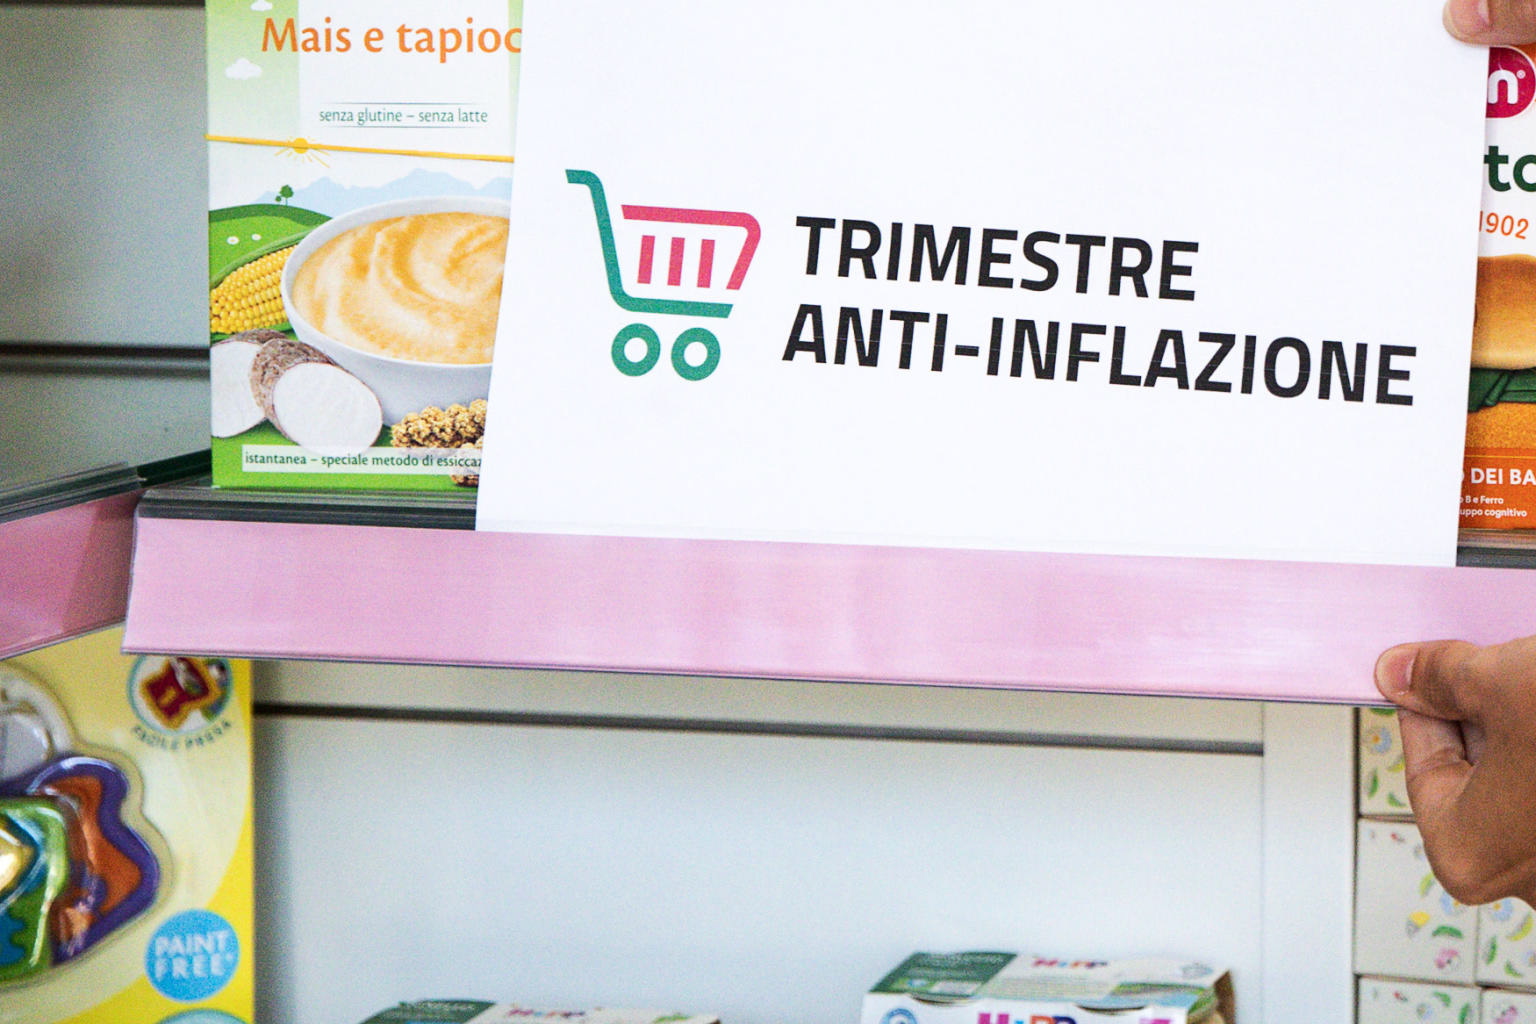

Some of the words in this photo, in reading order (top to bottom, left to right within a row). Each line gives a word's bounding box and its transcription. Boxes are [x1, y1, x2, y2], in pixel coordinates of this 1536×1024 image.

[261, 17, 352, 54] Mais
[363, 27, 384, 53] e
[396, 17, 522, 64] tapioc
[320, 111, 354, 123] senza
[357, 109, 402, 126] glutine
[418, 111, 456, 123] senza
[458, 109, 488, 123] latte
[796, 216, 1200, 301] TRIMESTRE
[782, 303, 1417, 407] ANTI-INFLAZIONE
[245, 452, 307, 465] istantanea
[321, 453, 369, 468] speciale
[371, 454, 419, 467] metodo
[422, 454, 434, 467] di
[1471, 468, 1504, 485] DEI
[1480, 495, 1504, 505] Ferro
[1484, 508, 1528, 519] cognitivo
[155, 930, 228, 956] PAINT
[154, 953, 225, 982] FREE
